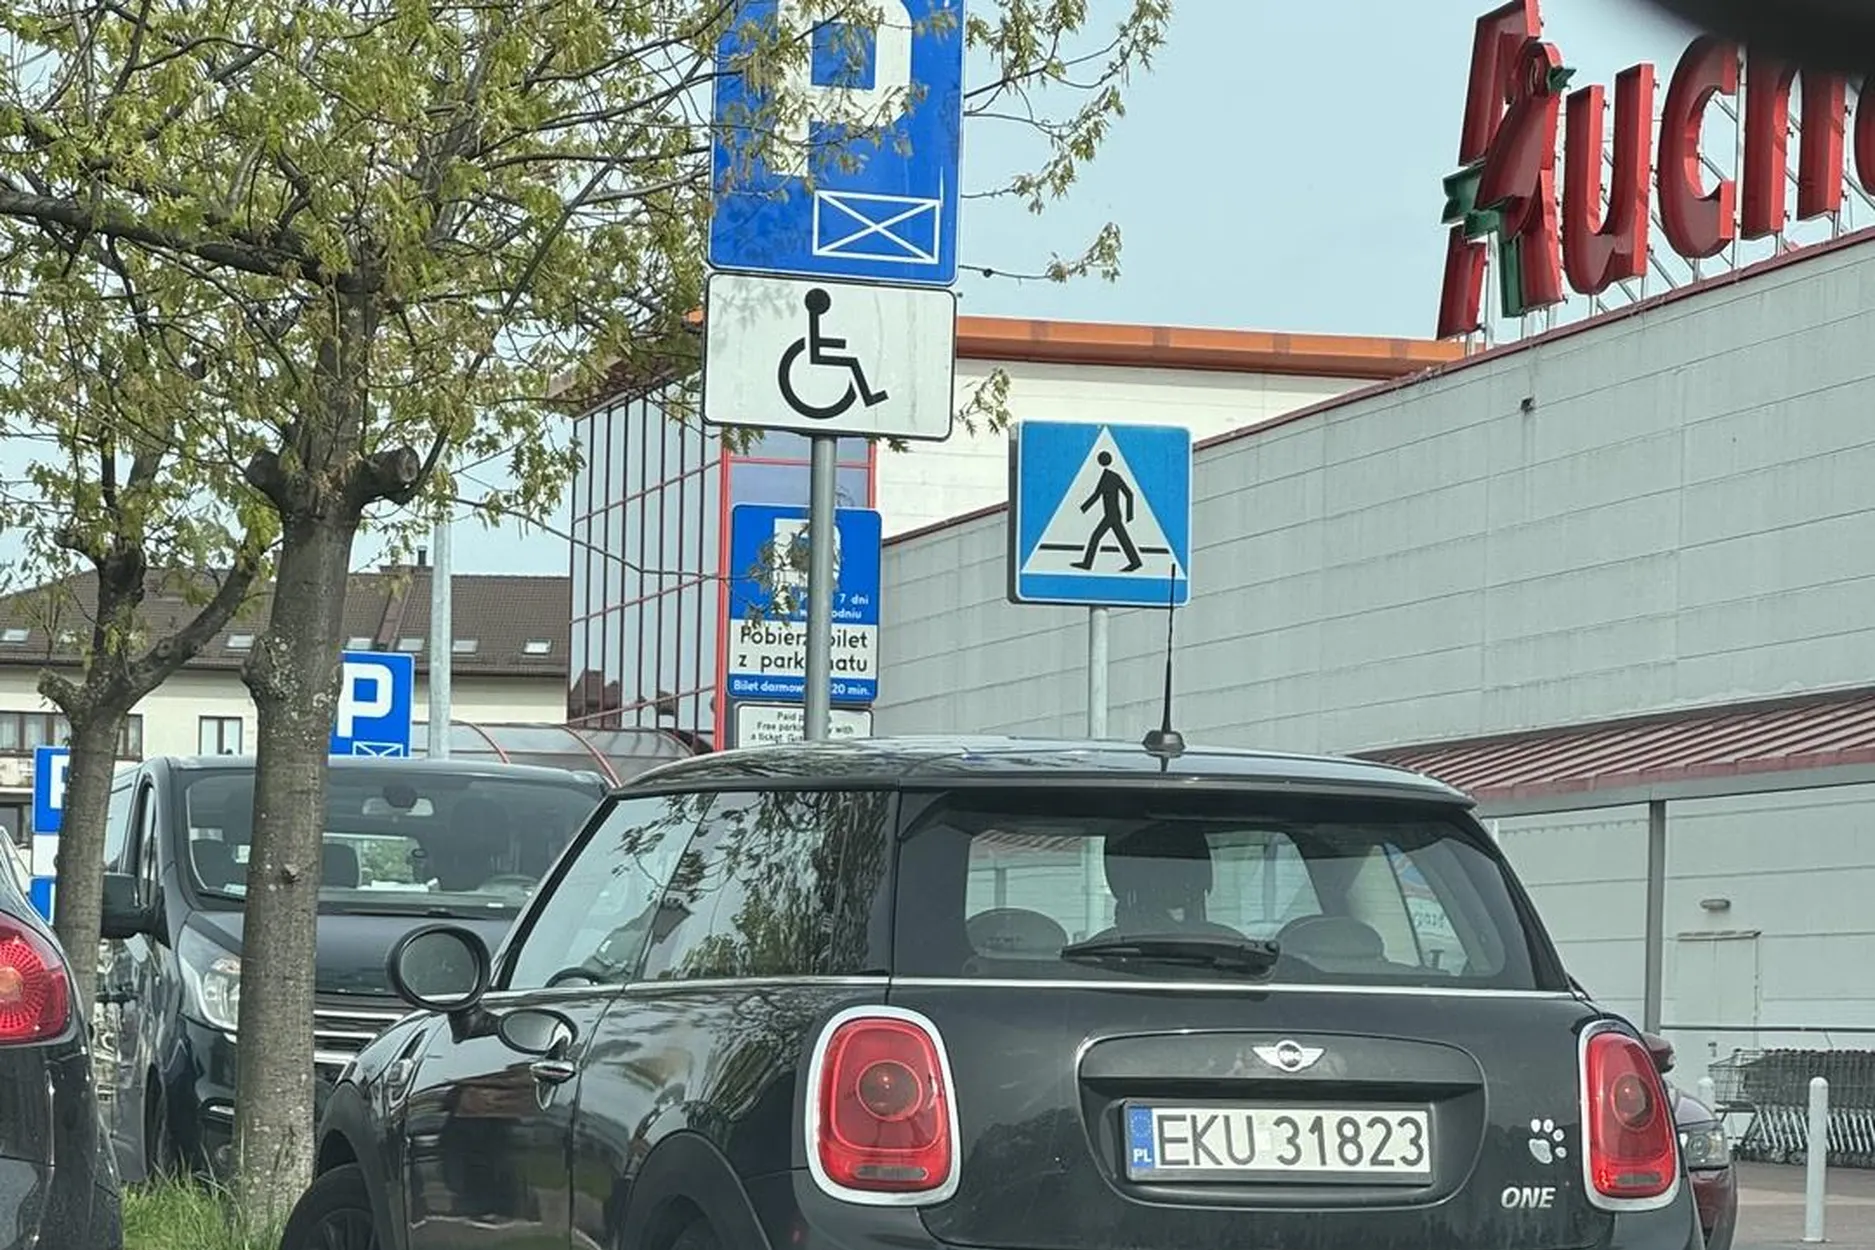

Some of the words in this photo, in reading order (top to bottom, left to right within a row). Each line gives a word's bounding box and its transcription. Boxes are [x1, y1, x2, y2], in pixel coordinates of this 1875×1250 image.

[770, 0, 912, 177] P
[840, 593, 846, 604] 7
[851, 594, 869, 605] dni
[739, 654, 747, 667] z
[761, 652, 867, 672] parkatu
[734, 680, 758, 692] Bilet
[760, 681, 805, 694] darmow
[832, 684, 846, 695] 20
[337, 663, 393, 737] P
[1157, 1114, 1256, 1166] EKU
[1272, 1115, 1424, 1167] 31823
[1133, 1148, 1152, 1162] PL
[1501, 1187, 1556, 1208] ONE
